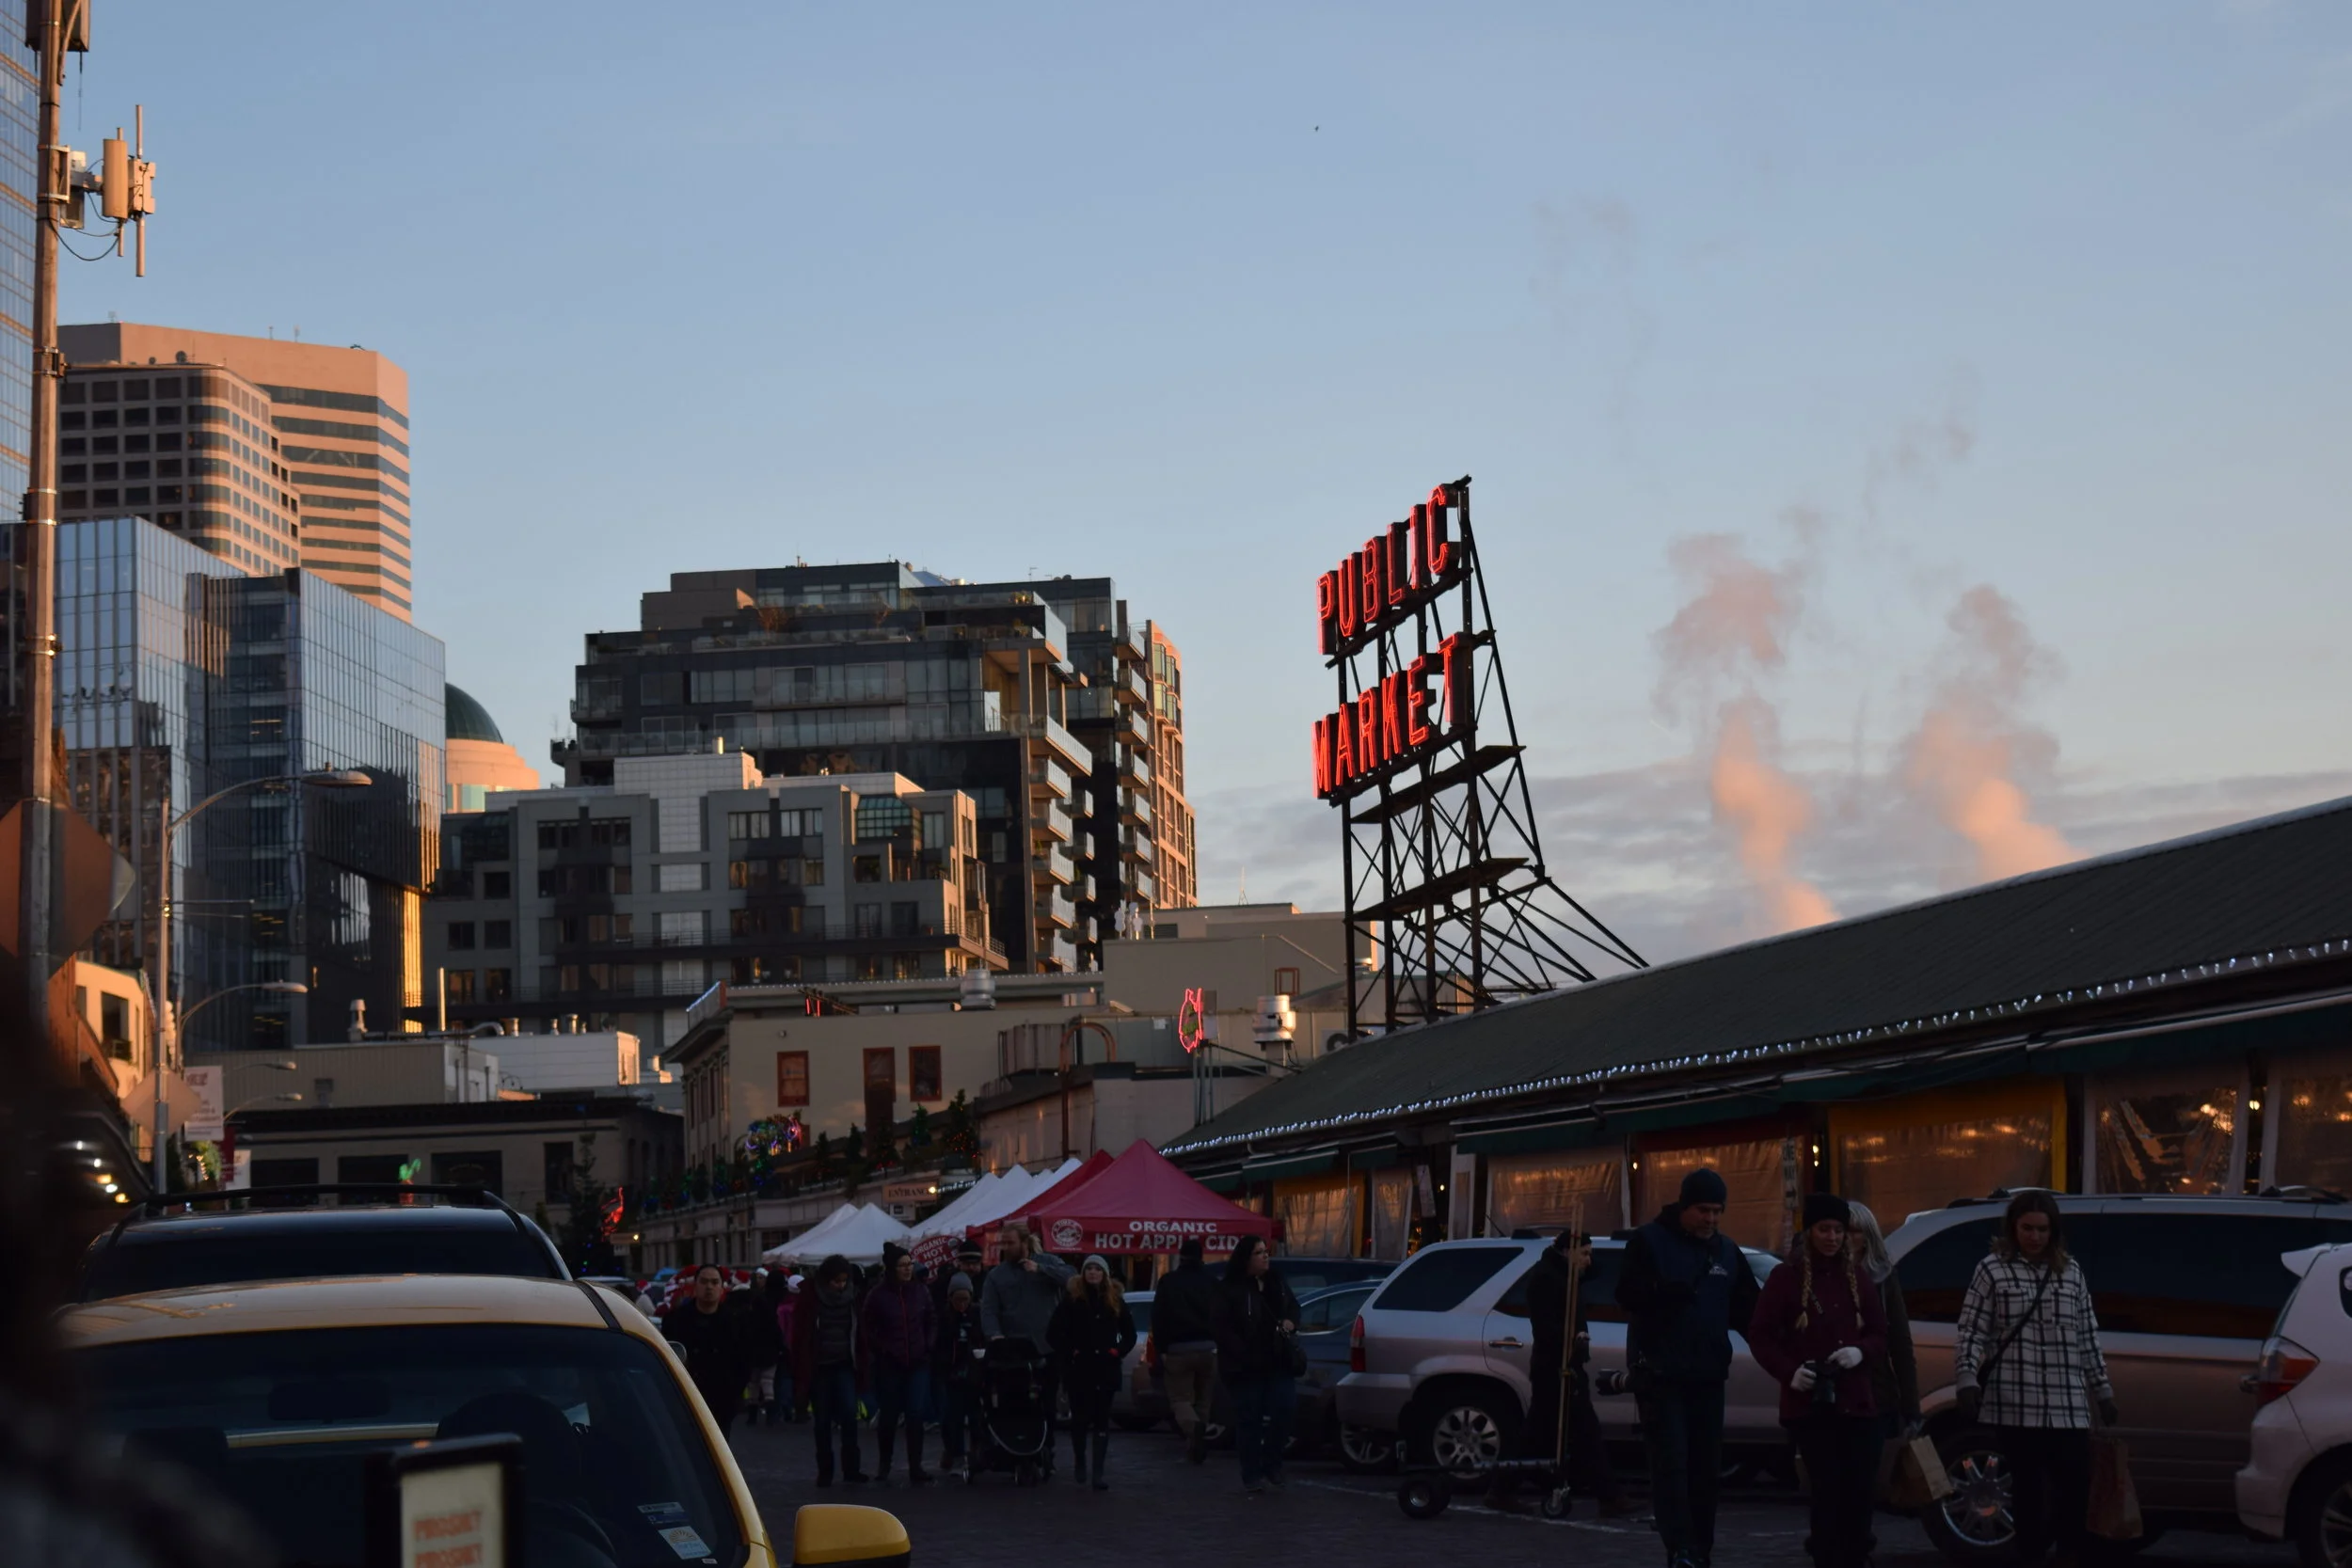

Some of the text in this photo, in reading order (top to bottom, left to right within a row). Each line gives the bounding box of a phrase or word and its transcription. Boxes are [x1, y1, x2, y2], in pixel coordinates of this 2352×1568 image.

[1315, 483, 1450, 656] PUBLIC
[1311, 632, 1458, 800] MARKET
[1784, 1165, 1795, 1180] WAY
[888, 1186, 933, 1197] ENTRANC
[1129, 1221, 1217, 1233] ORGANIC
[914, 1237, 947, 1256] ORGANIC
[1095, 1233, 1135, 1249] HOT
[1139, 1234, 1200, 1250] APPL
[1205, 1235, 1242, 1251] CID
[923, 1246, 945, 1260] HOT
[924, 1248, 959, 1270] PPLE
